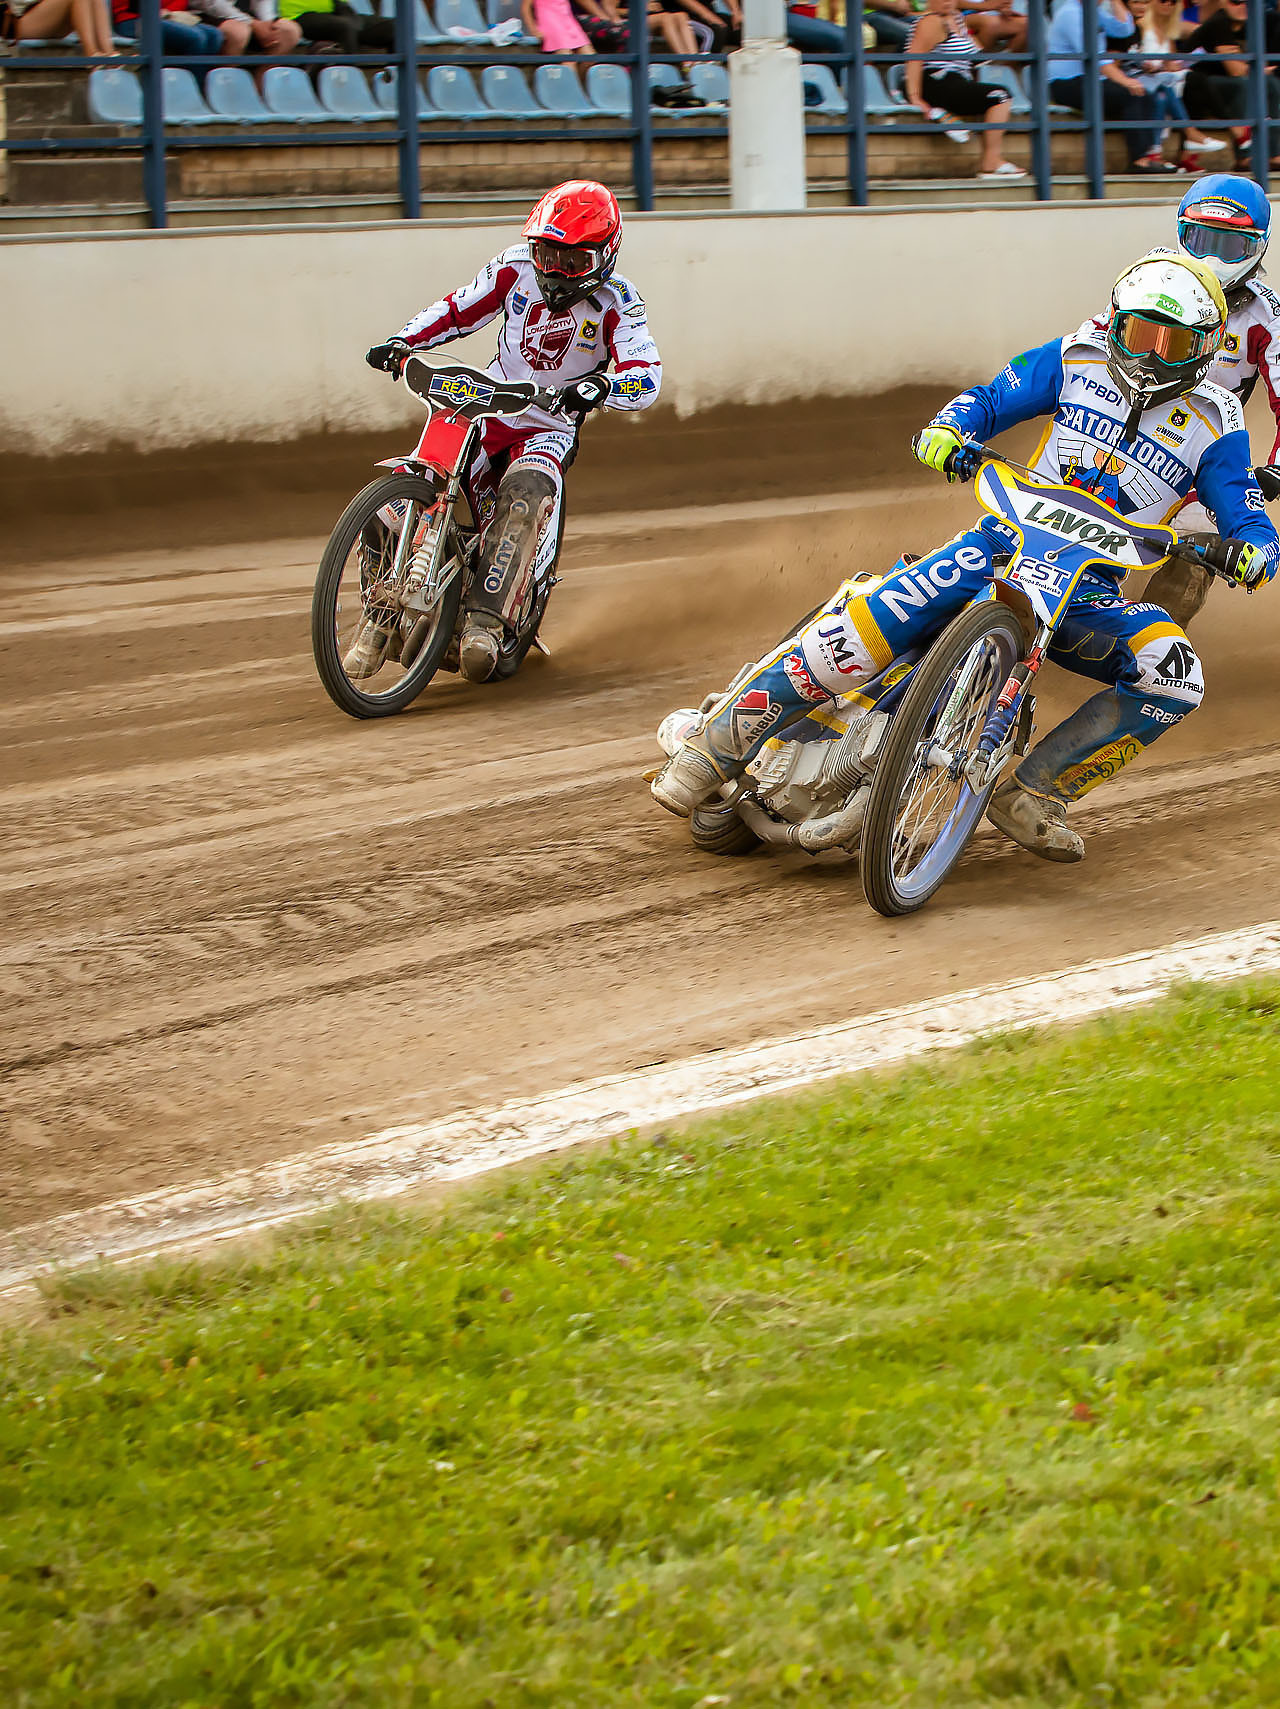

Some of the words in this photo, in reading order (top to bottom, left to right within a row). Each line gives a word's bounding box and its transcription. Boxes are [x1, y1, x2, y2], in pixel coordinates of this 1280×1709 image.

[1198, 308, 1213, 319] Nice
[441, 380, 480, 399] REALL
[1085, 382, 1123, 407] PBDI
[1024, 501, 1129, 557] LAVOR
[879, 546, 988, 624] Nice
[1016, 558, 1070, 586] FST
[818, 624, 864, 676] JMS
[1152, 677, 1182, 689] AUTO
[746, 702, 783, 745] ARBUD
